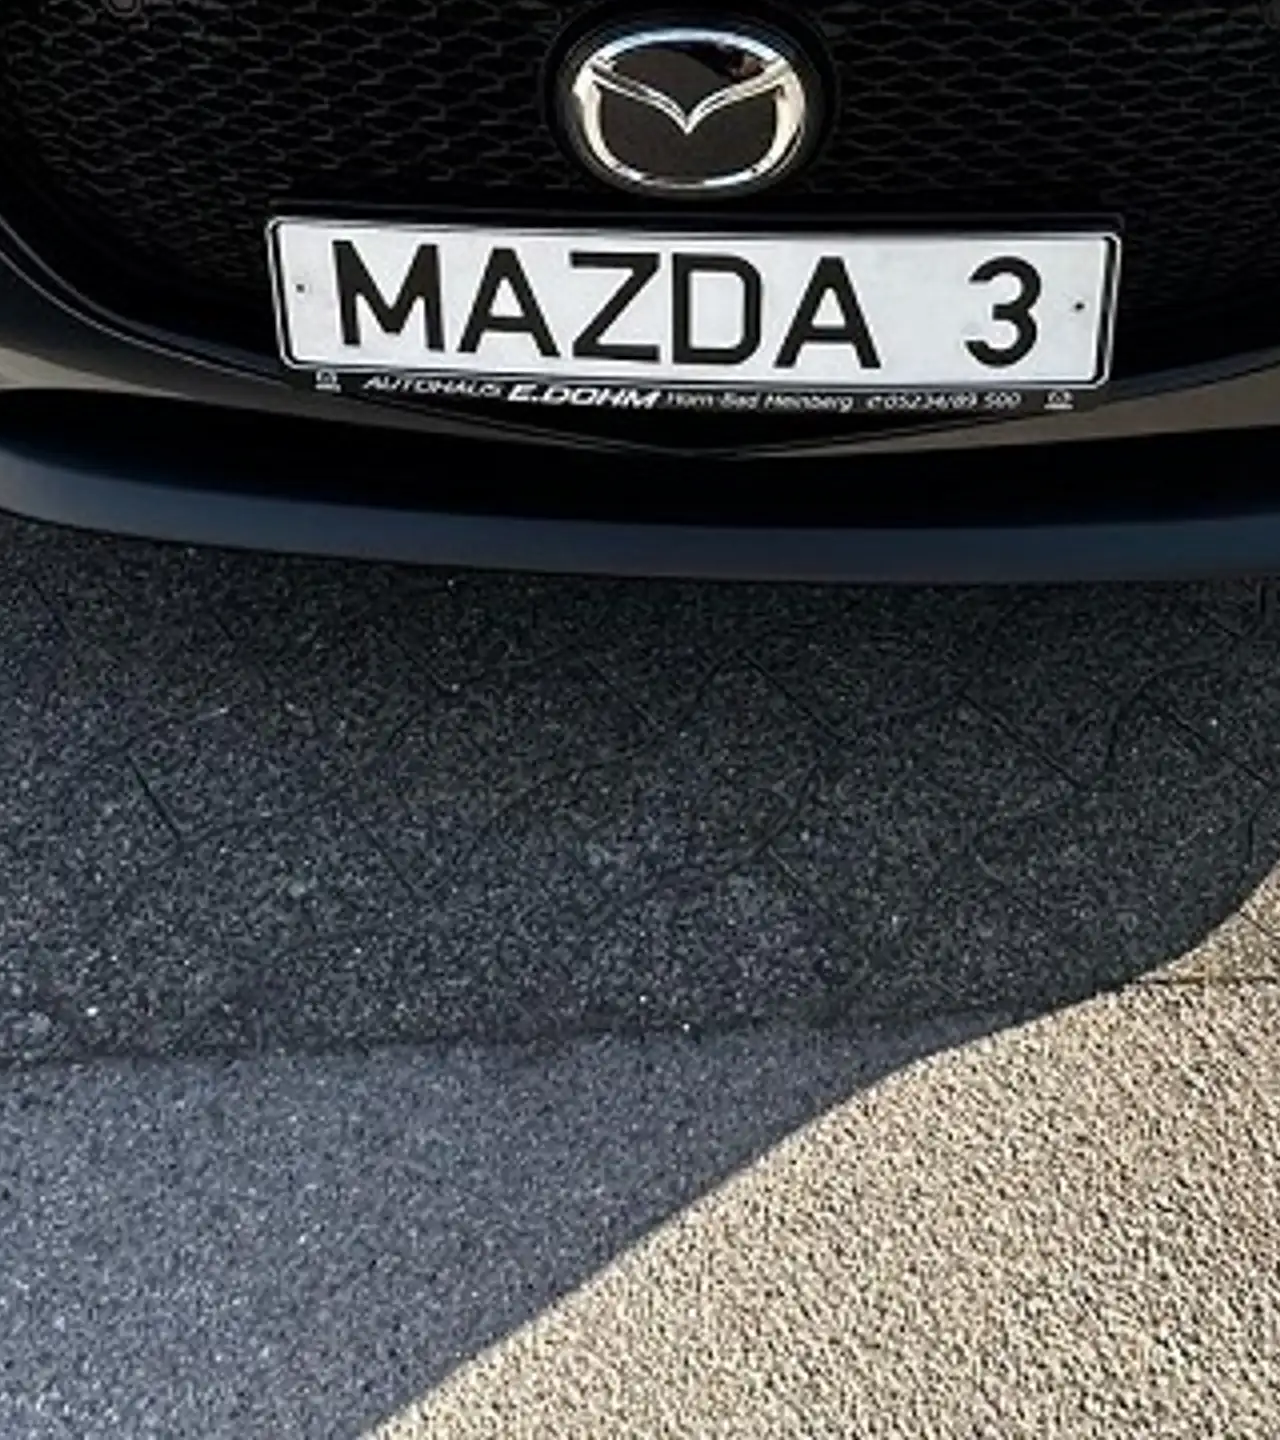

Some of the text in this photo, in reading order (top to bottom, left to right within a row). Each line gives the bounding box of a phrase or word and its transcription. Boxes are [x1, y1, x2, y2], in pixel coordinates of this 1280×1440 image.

[332, 240, 1042, 369] MAZDA 3
[363, 375, 501, 399] AUTOHAUS
[508, 383, 661, 410] E.DOHM
